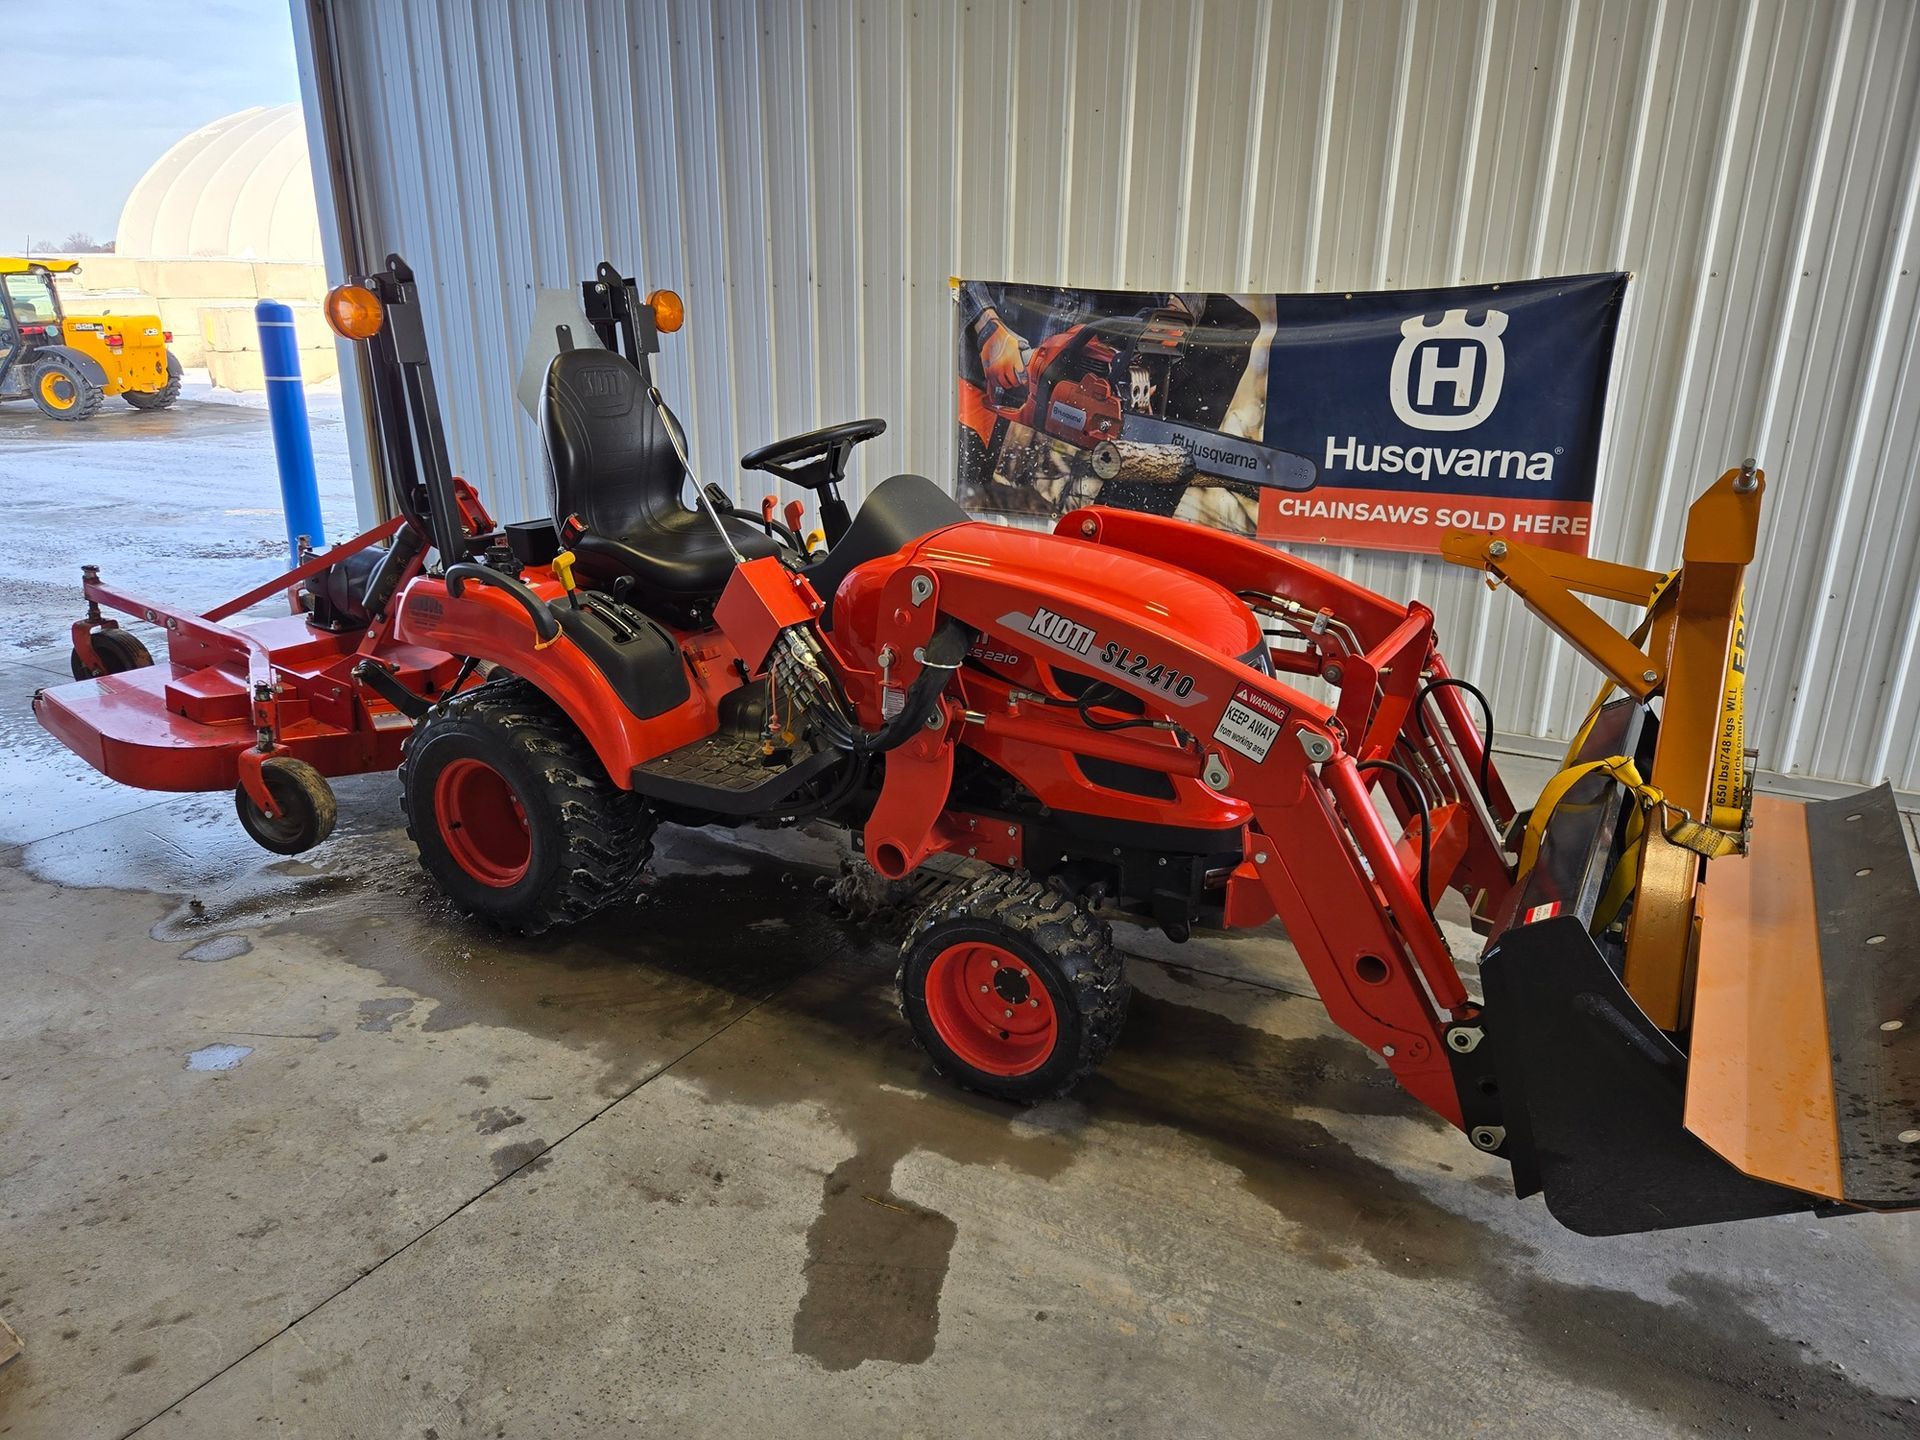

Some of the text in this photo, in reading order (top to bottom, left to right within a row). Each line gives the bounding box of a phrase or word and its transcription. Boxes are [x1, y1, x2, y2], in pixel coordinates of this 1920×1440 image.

[1185, 438, 1259, 470] Husqvarna
[1278, 498, 1588, 536] CHAINSAWS SOLD HERE
[1028, 606, 1196, 700] KIOTI SL2410
[1249, 693, 1286, 720] WARNING
[1725, 687, 1738, 712] WLL
[1225, 705, 1276, 741] KEEP AWAY
[1723, 717, 1736, 738] kgs
[1219, 723, 1266, 757] from working area
